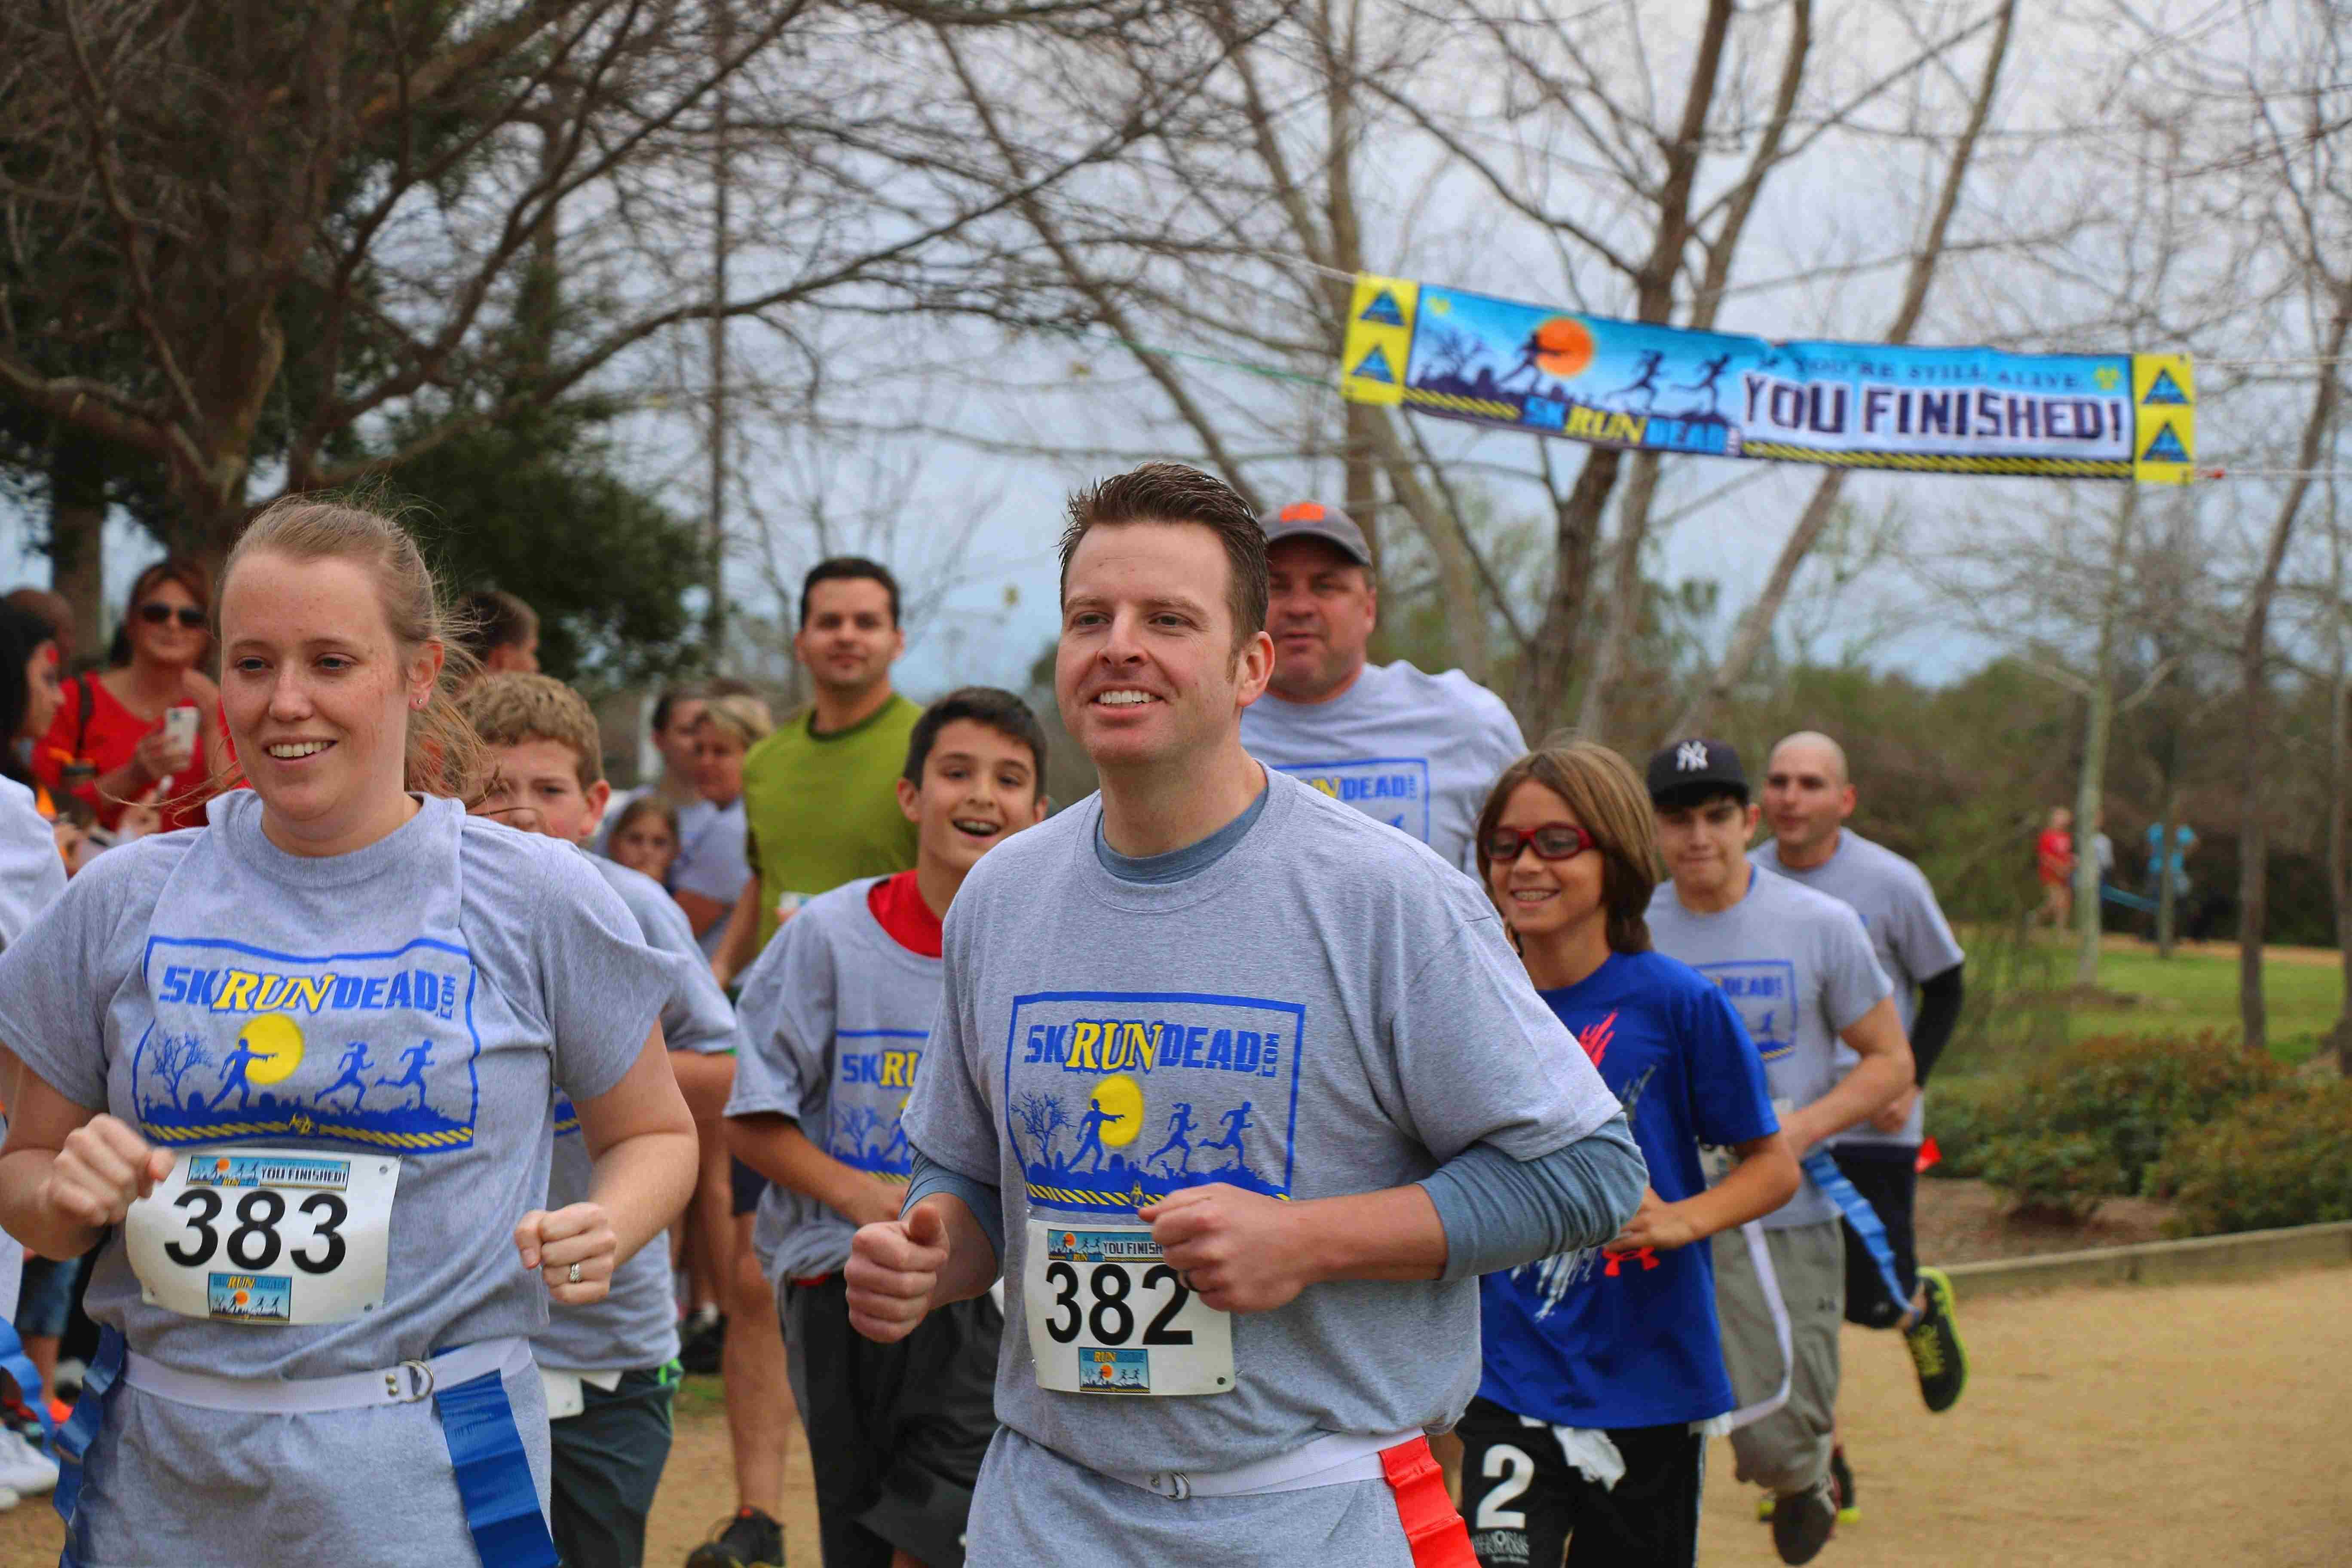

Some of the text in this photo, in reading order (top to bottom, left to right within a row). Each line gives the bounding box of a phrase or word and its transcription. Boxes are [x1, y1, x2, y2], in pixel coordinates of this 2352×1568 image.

[1743, 373, 2122, 442] YOU FINISHED!
[1677, 740, 1708, 771] NY
[262, 1167, 285, 1179] YOU
[164, 1188, 348, 1274] 383
[1103, 1242, 1123, 1254] YOU
[1045, 1261, 1194, 1346] 382
[1477, 1444, 1535, 1529] 2
